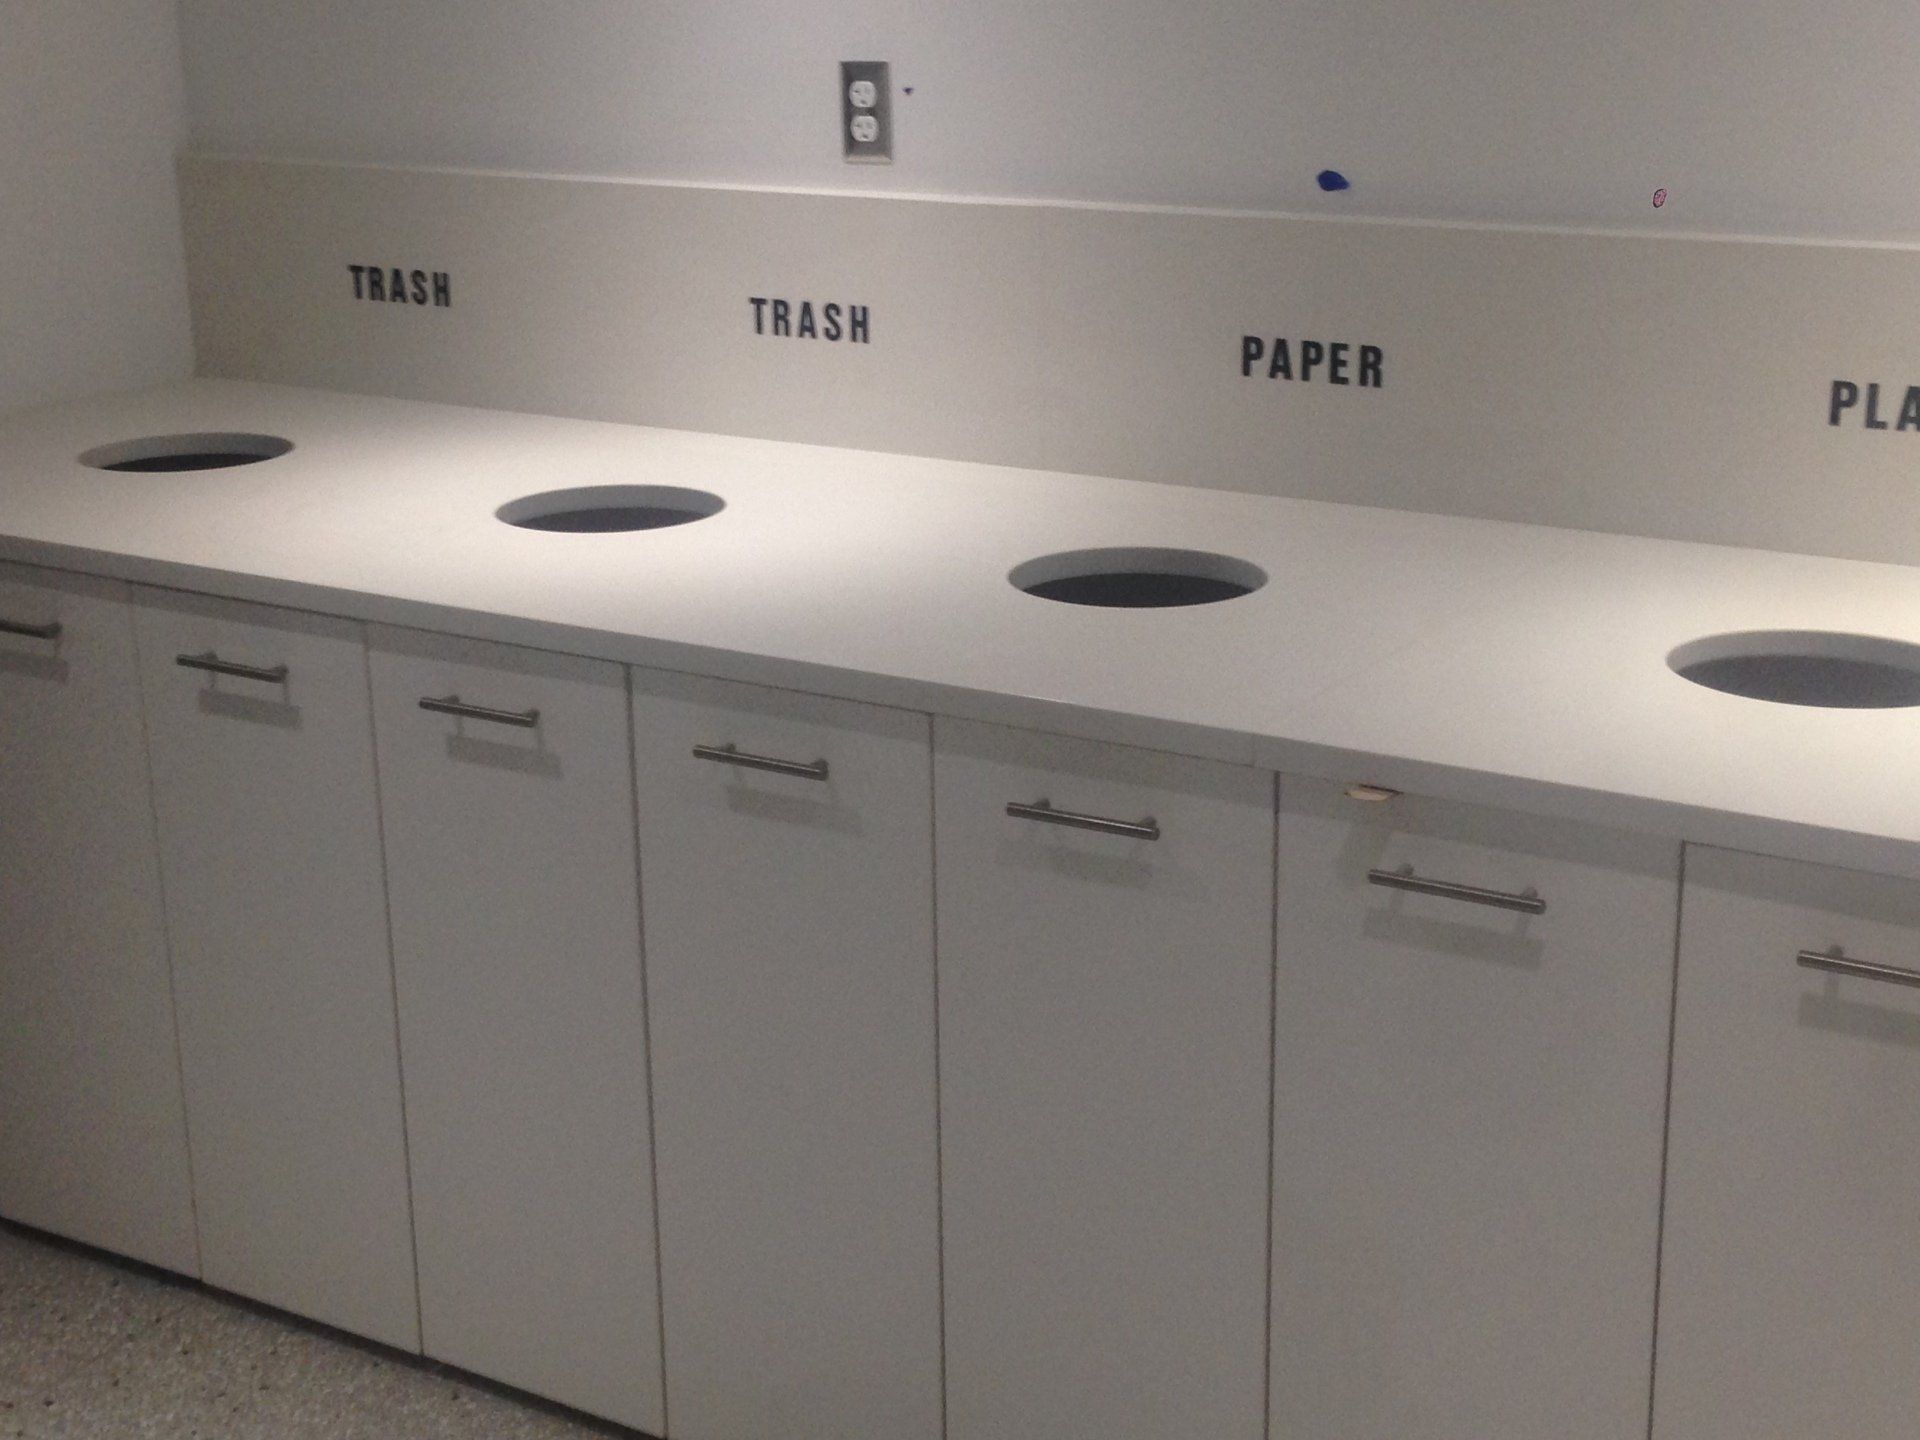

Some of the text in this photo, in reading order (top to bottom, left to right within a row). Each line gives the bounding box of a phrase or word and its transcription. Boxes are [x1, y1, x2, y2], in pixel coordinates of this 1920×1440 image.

[348, 264, 451, 307] TRASH
[748, 297, 869, 344] TRASH
[1241, 335, 1383, 389] PAPER
[1828, 379, 1920, 432] PLA
